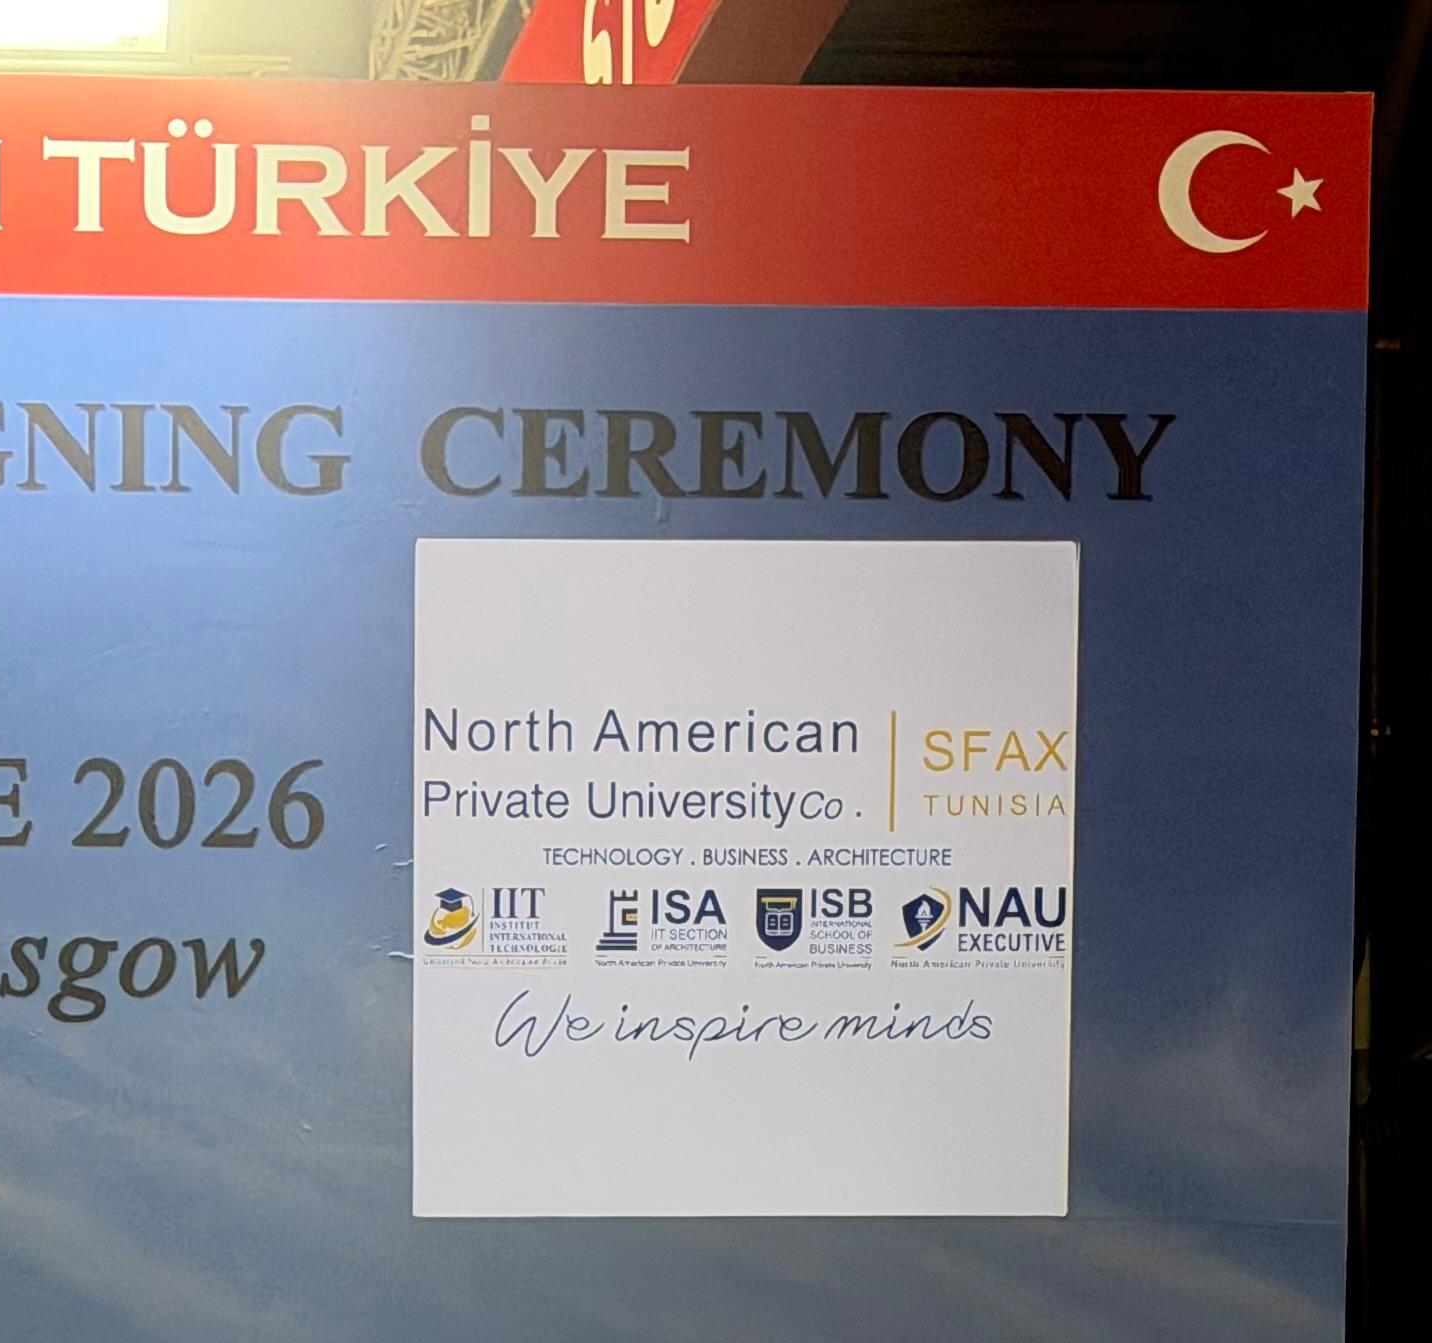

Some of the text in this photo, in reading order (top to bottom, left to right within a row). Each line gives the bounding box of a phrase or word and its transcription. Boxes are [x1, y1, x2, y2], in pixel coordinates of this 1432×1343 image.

[42, 113, 691, 244] TÜRKİYE
[421, 406, 1177, 503] CEREMONY
[424, 708, 858, 753] North American
[923, 729, 1068, 772] SFAX
[71, 757, 325, 849] 2026
[424, 780, 569, 819] Private
[924, 794, 1065, 816] TUNISIA
[542, 847, 952, 866] TECHNOLOGY BUSINESS ARCHITECTURE
[492, 887, 546, 919] IIT
[651, 889, 727, 925] ISA
[810, 888, 872, 918] ISB
[958, 887, 1067, 928] NAU
[669, 928, 728, 941] SECTION
[809, 930, 872, 940] SCHOOL OF
[809, 943, 872, 955] BUSINESS
[958, 933, 1066, 952] EXECUTIVE
[495, 989, 993, 1061] We inspire minds
